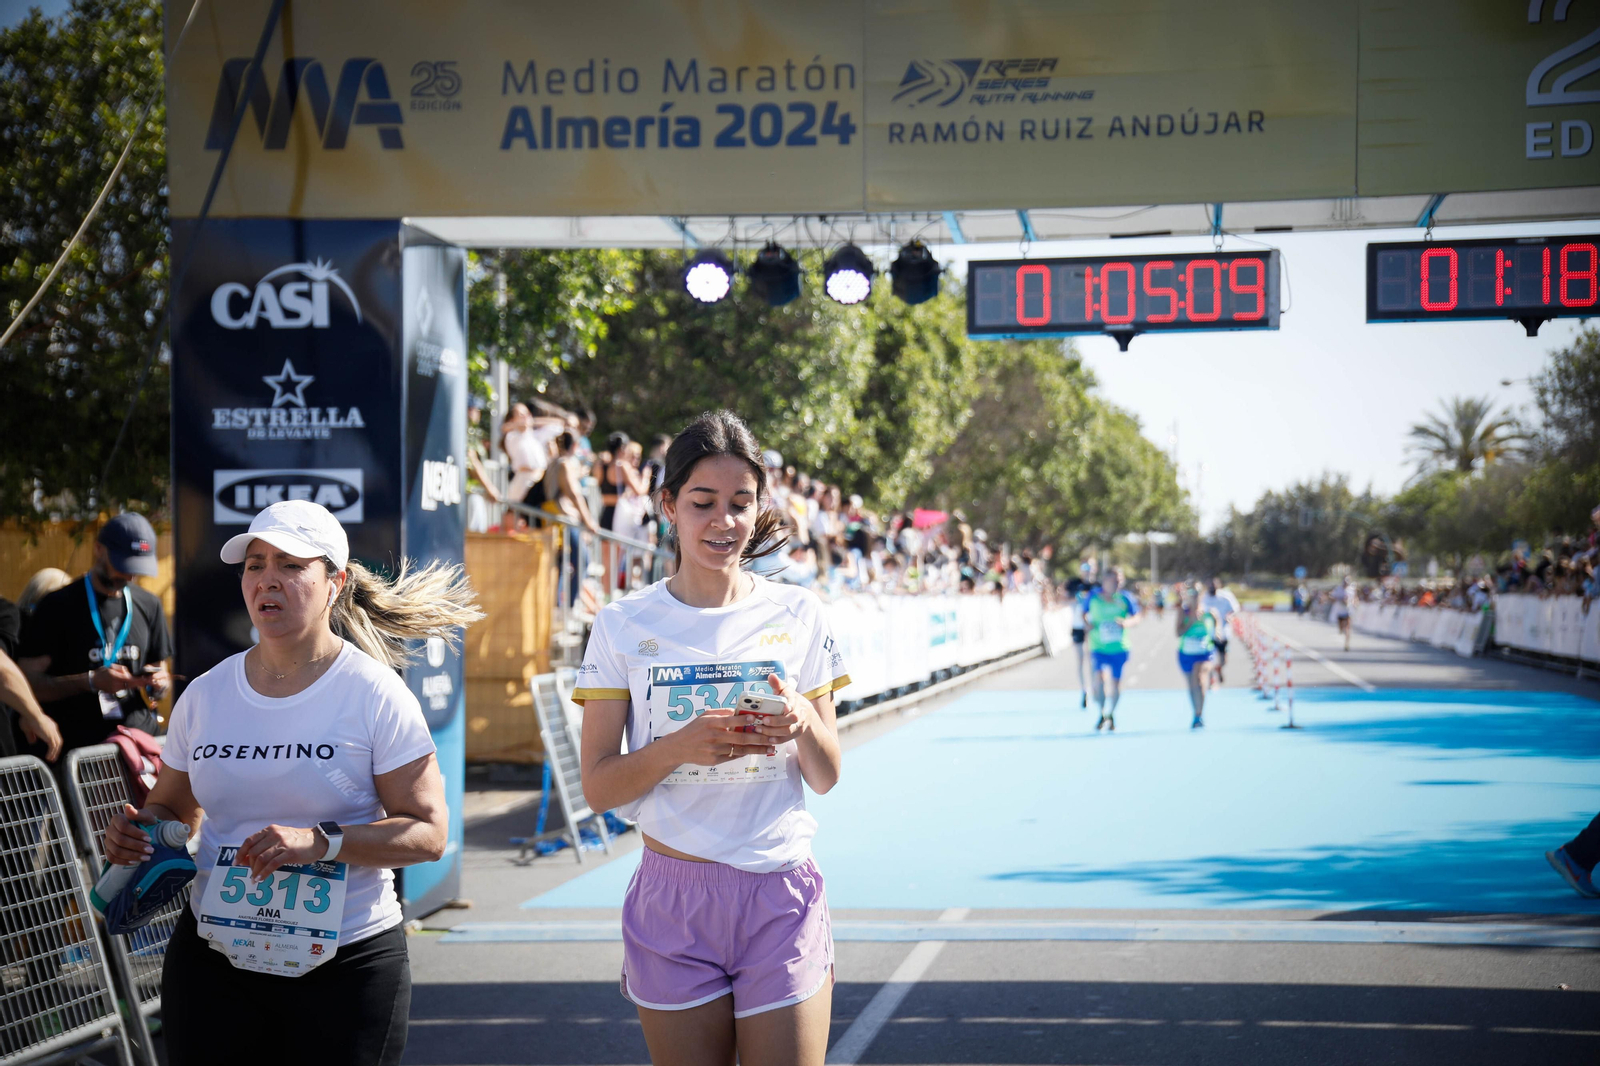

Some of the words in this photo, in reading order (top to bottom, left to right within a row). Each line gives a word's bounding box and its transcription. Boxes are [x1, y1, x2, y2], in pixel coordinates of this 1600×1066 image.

[410, 61, 461, 97] 25
[501, 58, 639, 95] Medio
[662, 55, 855, 94] Maratón
[974, 77, 1051, 91] SERIES
[968, 92, 1016, 106] RUTA
[1021, 89, 1096, 105] RUNNING
[500, 102, 702, 150] Almería
[714, 101, 857, 148] 2024
[887, 115, 1005, 144] RAMÓN
[1019, 117, 1094, 141] RUIZ
[1107, 107, 1266, 139] ANDÚJAR
[210, 280, 331, 330] CASI
[212, 407, 366, 430] ESTRELLA
[247, 428, 266, 440] DE
[268, 427, 332, 440] LEVANTE
[638, 638, 659, 653] 25
[695, 671, 722, 680] Almería
[722, 669, 743, 678] 2024
[193, 743, 334, 761] COSENTINO
[219, 867, 331, 914] 5313
[256, 907, 281, 919] ANA
[232, 938, 256, 948] NEXAL
[274, 942, 299, 951] ALMERÍA
